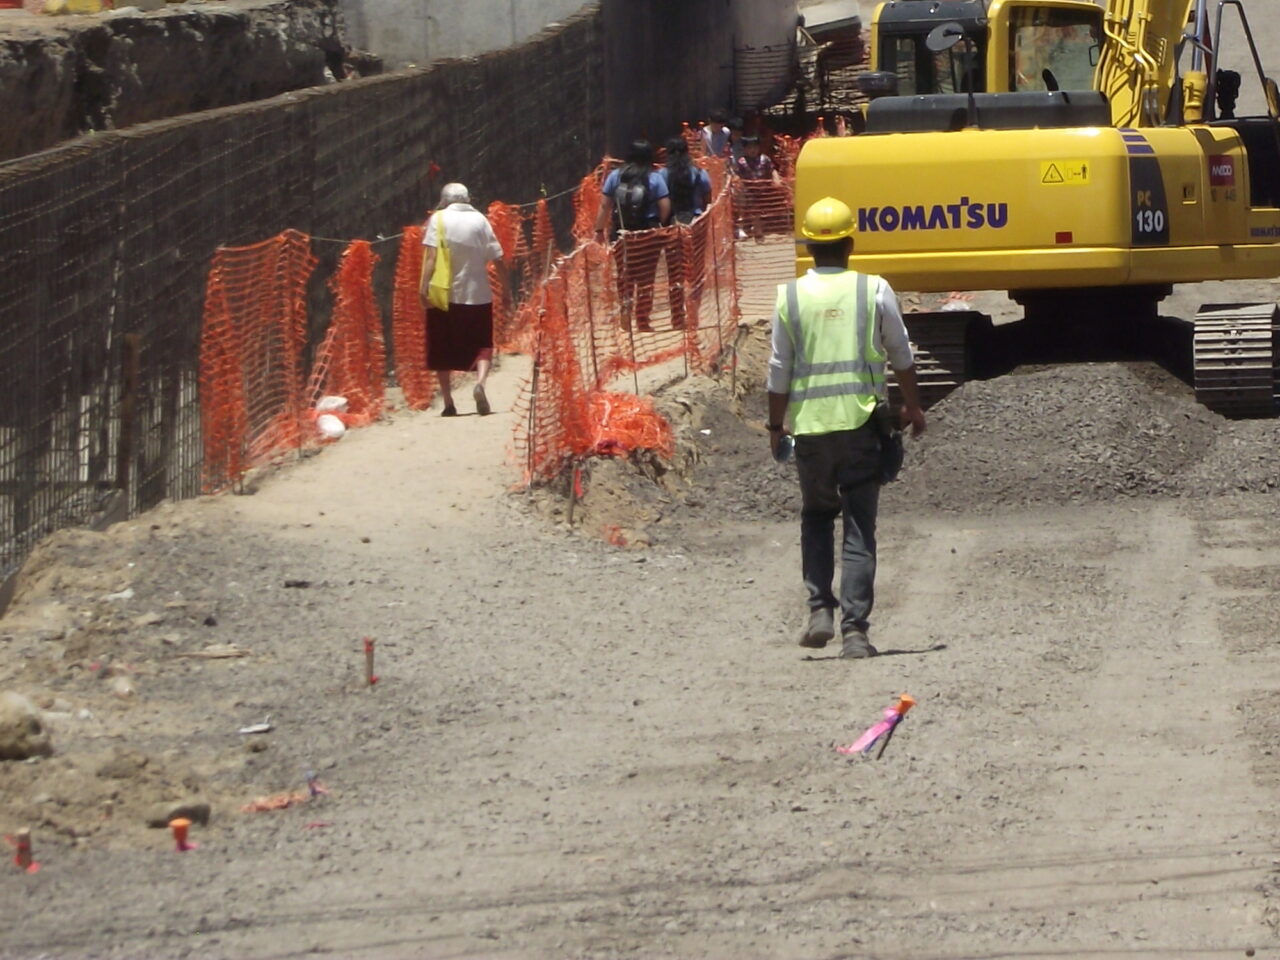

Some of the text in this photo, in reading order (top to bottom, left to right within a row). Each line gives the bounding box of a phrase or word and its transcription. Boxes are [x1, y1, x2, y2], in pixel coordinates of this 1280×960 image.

[1137, 191, 1151, 206] PC
[858, 196, 1008, 232] KOMATSU
[1137, 210, 1163, 232] 130
